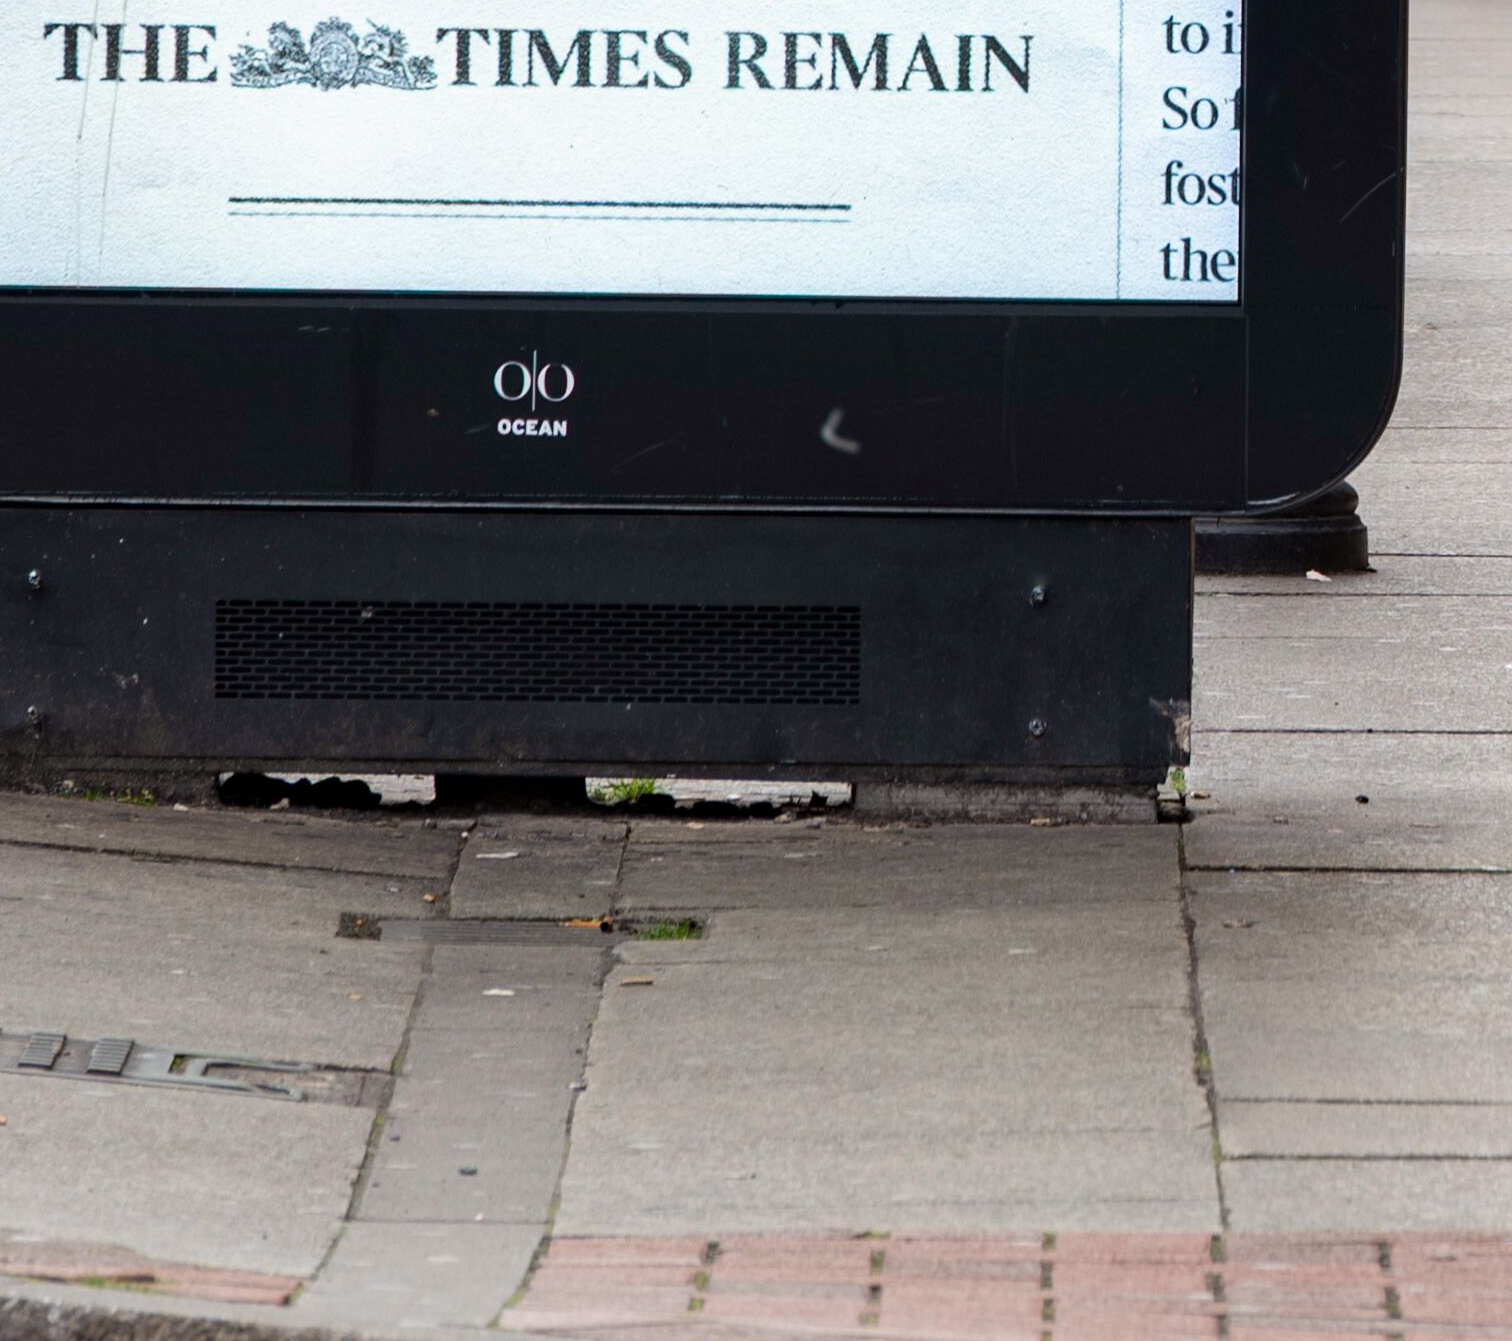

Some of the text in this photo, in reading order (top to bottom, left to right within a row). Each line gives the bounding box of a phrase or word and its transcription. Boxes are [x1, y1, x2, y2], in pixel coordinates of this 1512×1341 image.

[42, 22, 1035, 94] THE TIMES REMAIN
[497, 417, 569, 438] OCEAN
